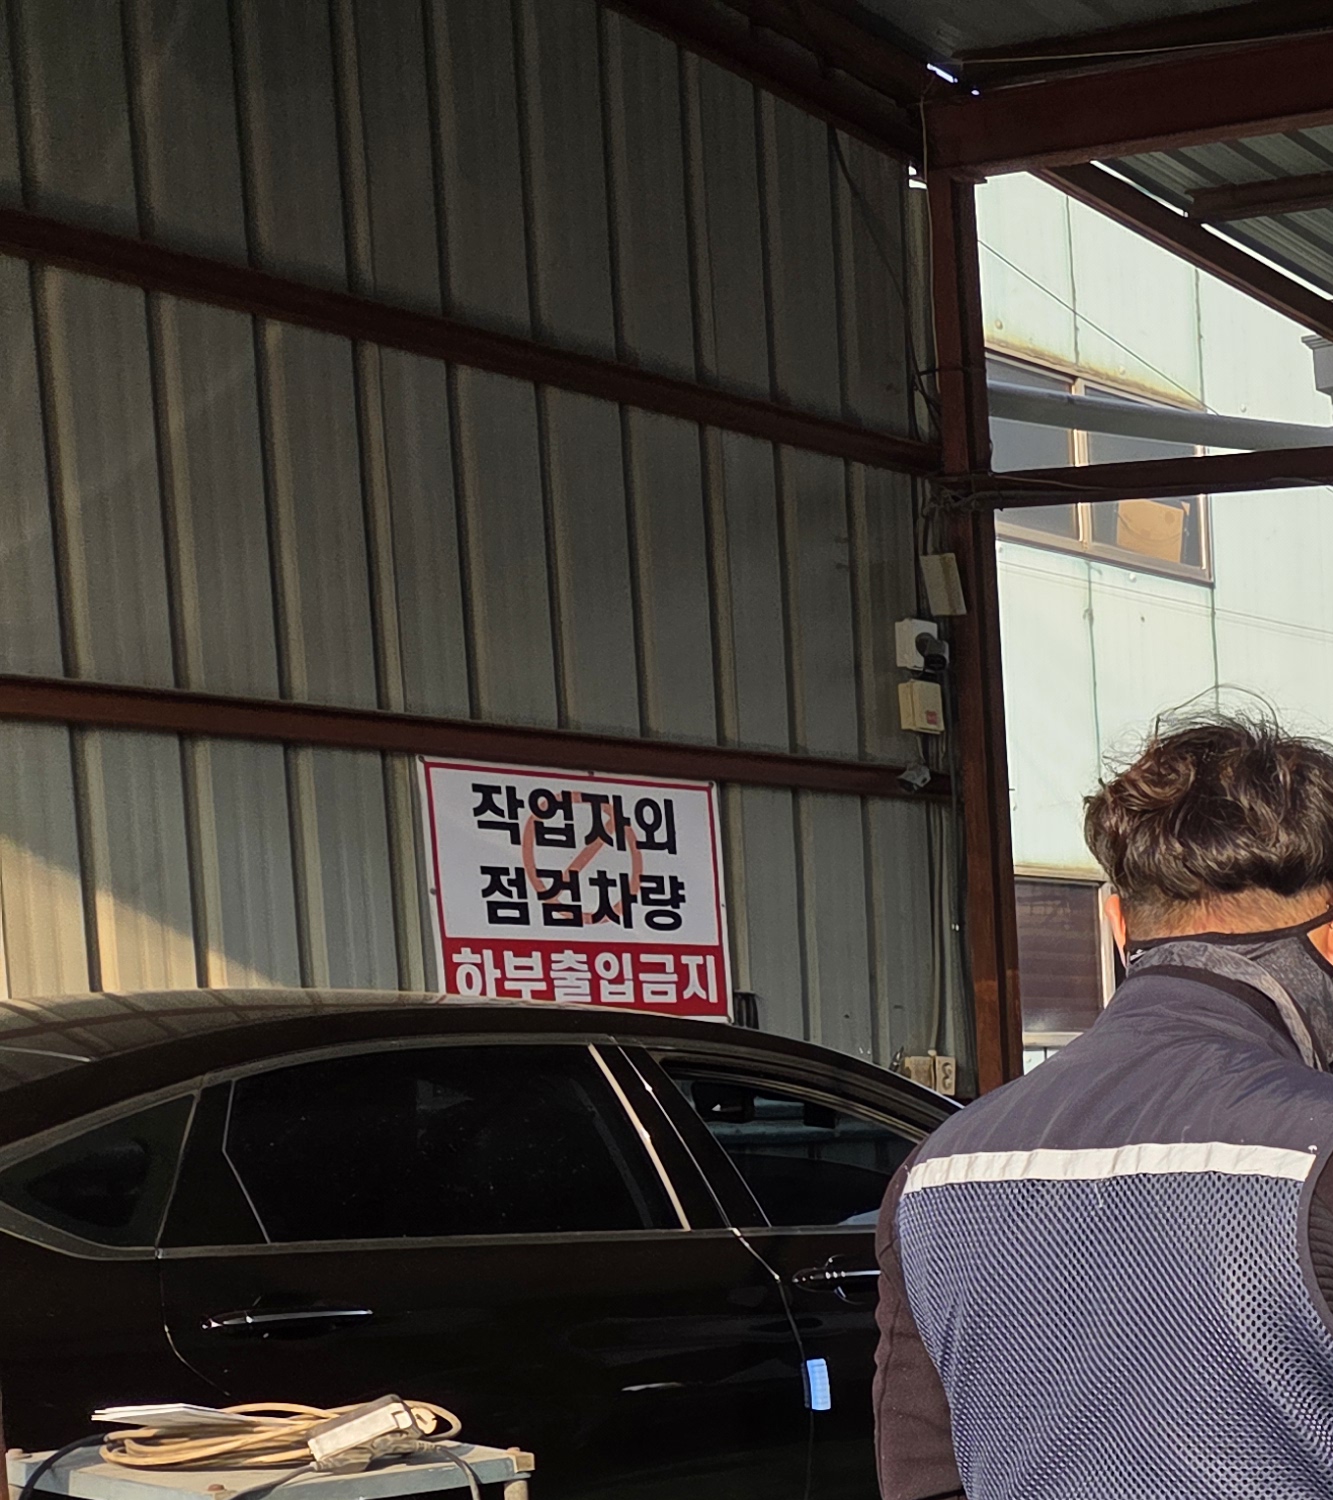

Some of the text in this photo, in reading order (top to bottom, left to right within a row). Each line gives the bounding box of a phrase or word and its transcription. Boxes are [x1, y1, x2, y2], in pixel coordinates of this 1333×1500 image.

[471, 783, 677, 855] 작업자외
[480, 865, 686, 931] 점검차량
[452, 948, 718, 1003] 하부출입금지
